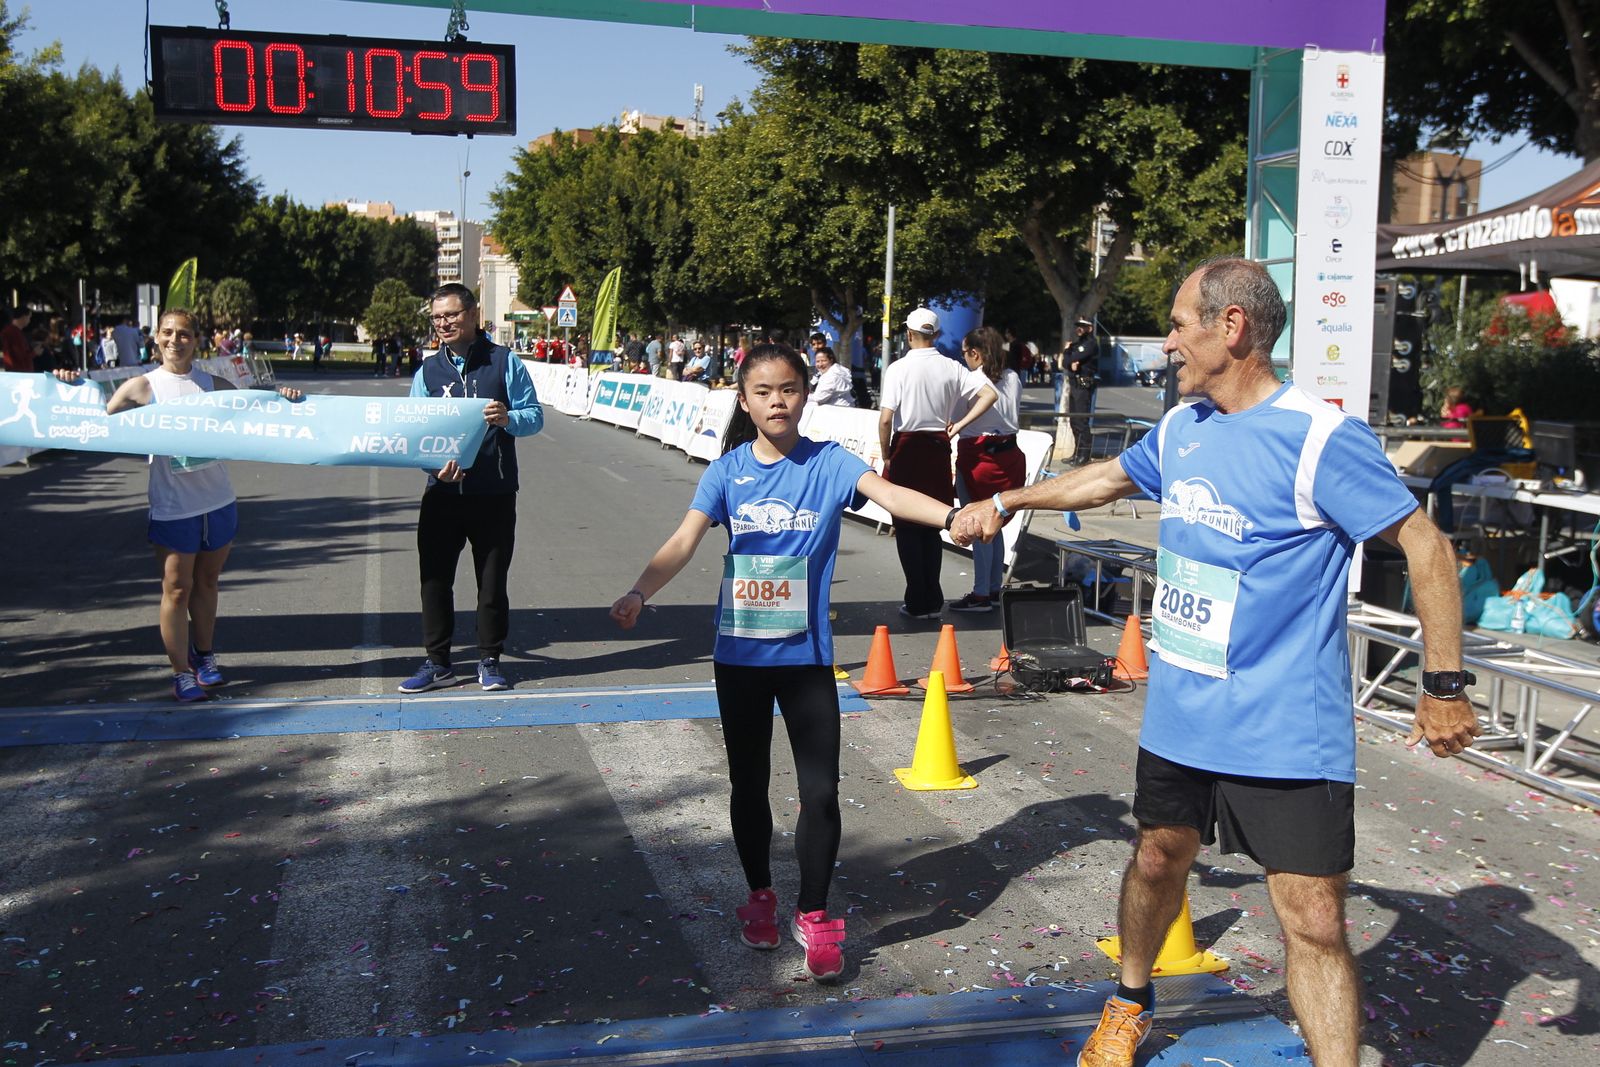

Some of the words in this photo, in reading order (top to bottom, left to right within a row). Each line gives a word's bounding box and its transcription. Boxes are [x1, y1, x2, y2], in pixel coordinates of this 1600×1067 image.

[1325, 114, 1358, 128] NEXA
[1324, 138, 1356, 156] CDX
[1326, 272, 1353, 282] cajamar
[1322, 291, 1346, 307] ego
[1321, 323, 1352, 334] aqualia
[51, 404, 109, 417] CARRERA
[291, 403, 317, 417] ES
[394, 402, 461, 417] ALMERÍA
[119, 413, 237, 434] NUESTRA
[394, 416, 429, 424] CIUDAD
[49, 421, 110, 443] mujer
[350, 433, 408, 455] NEXA
[418, 434, 466, 455] CDX
[1201, 513, 1241, 537] RUNNIG
[734, 579, 792, 601] 2084
[743, 600, 781, 608] GUADALUPE
[1159, 583, 1213, 625] 2085
